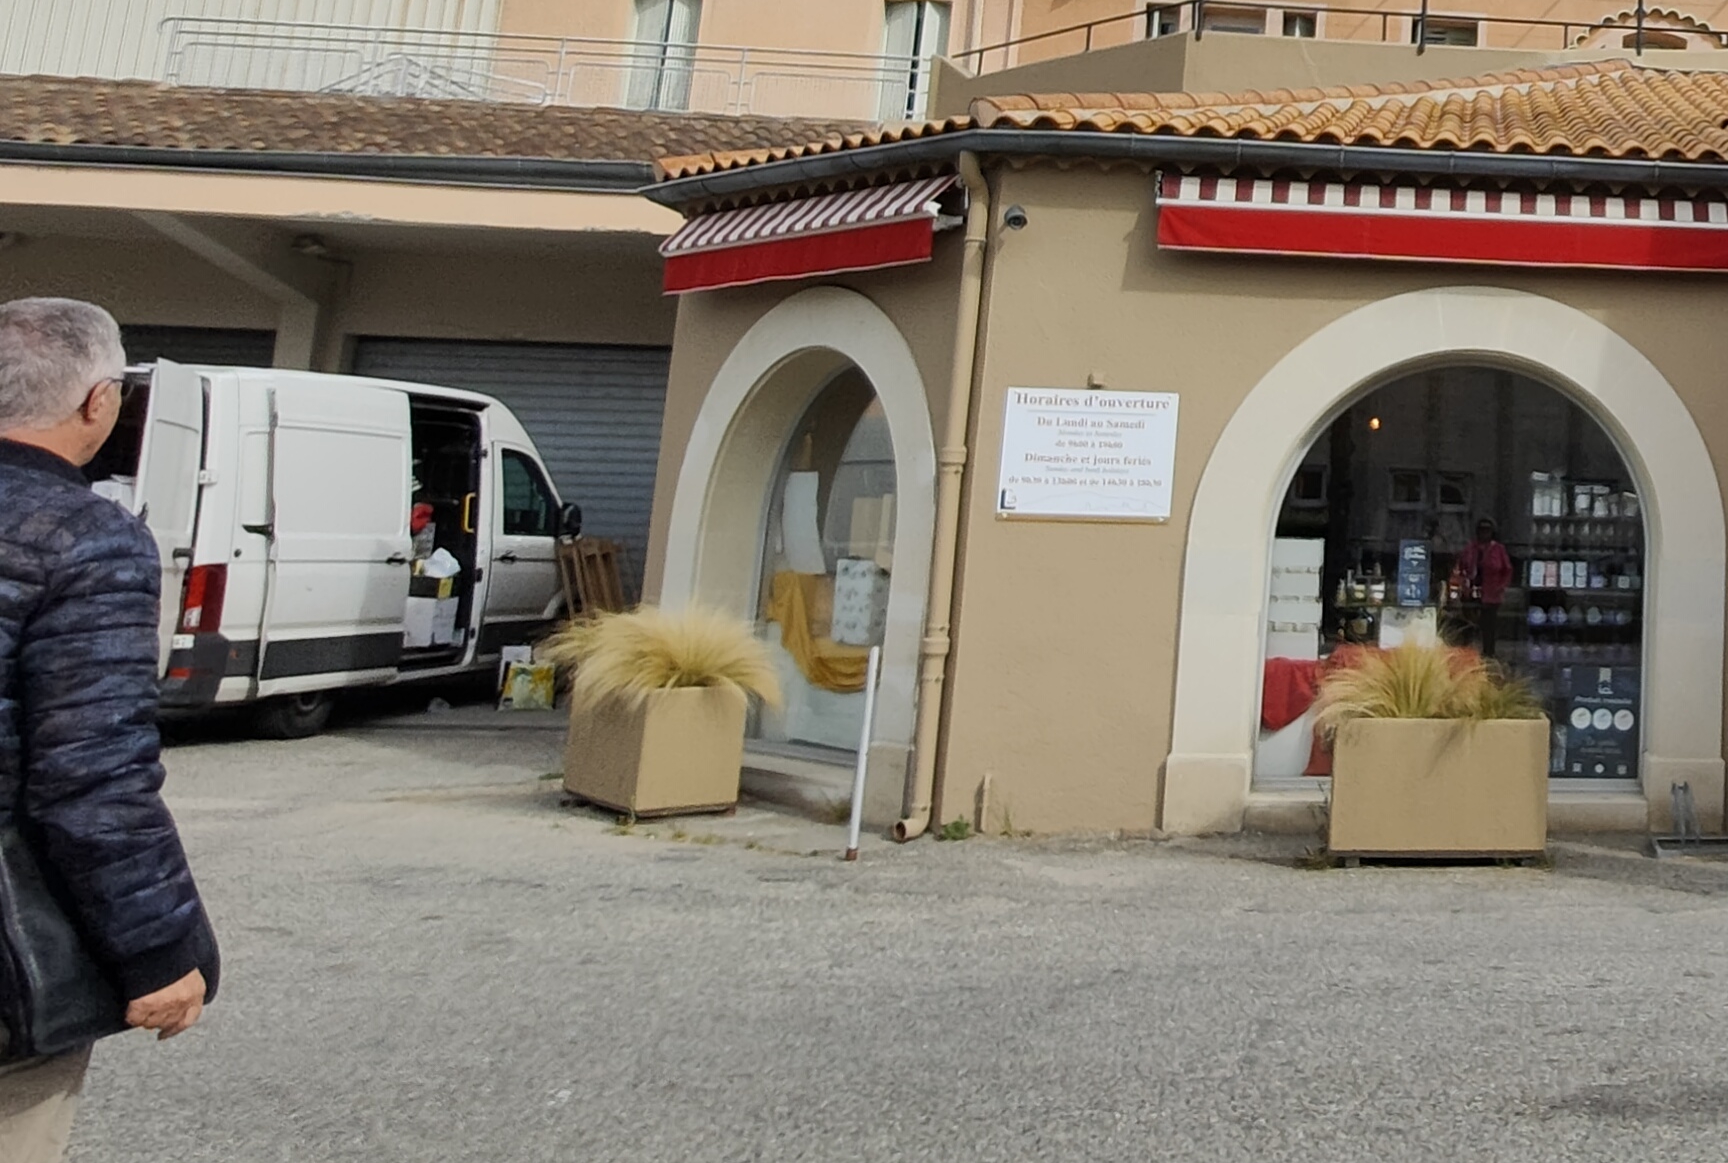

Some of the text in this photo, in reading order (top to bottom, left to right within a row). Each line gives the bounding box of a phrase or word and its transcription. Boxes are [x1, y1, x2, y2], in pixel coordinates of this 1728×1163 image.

[1014, 392, 1170, 410] Horaires d'ouverture
[1036, 416, 1146, 429] Du Lundi au Samedi
[1024, 452, 1077, 464] Dimanche
[1080, 454, 1090, 464] et
